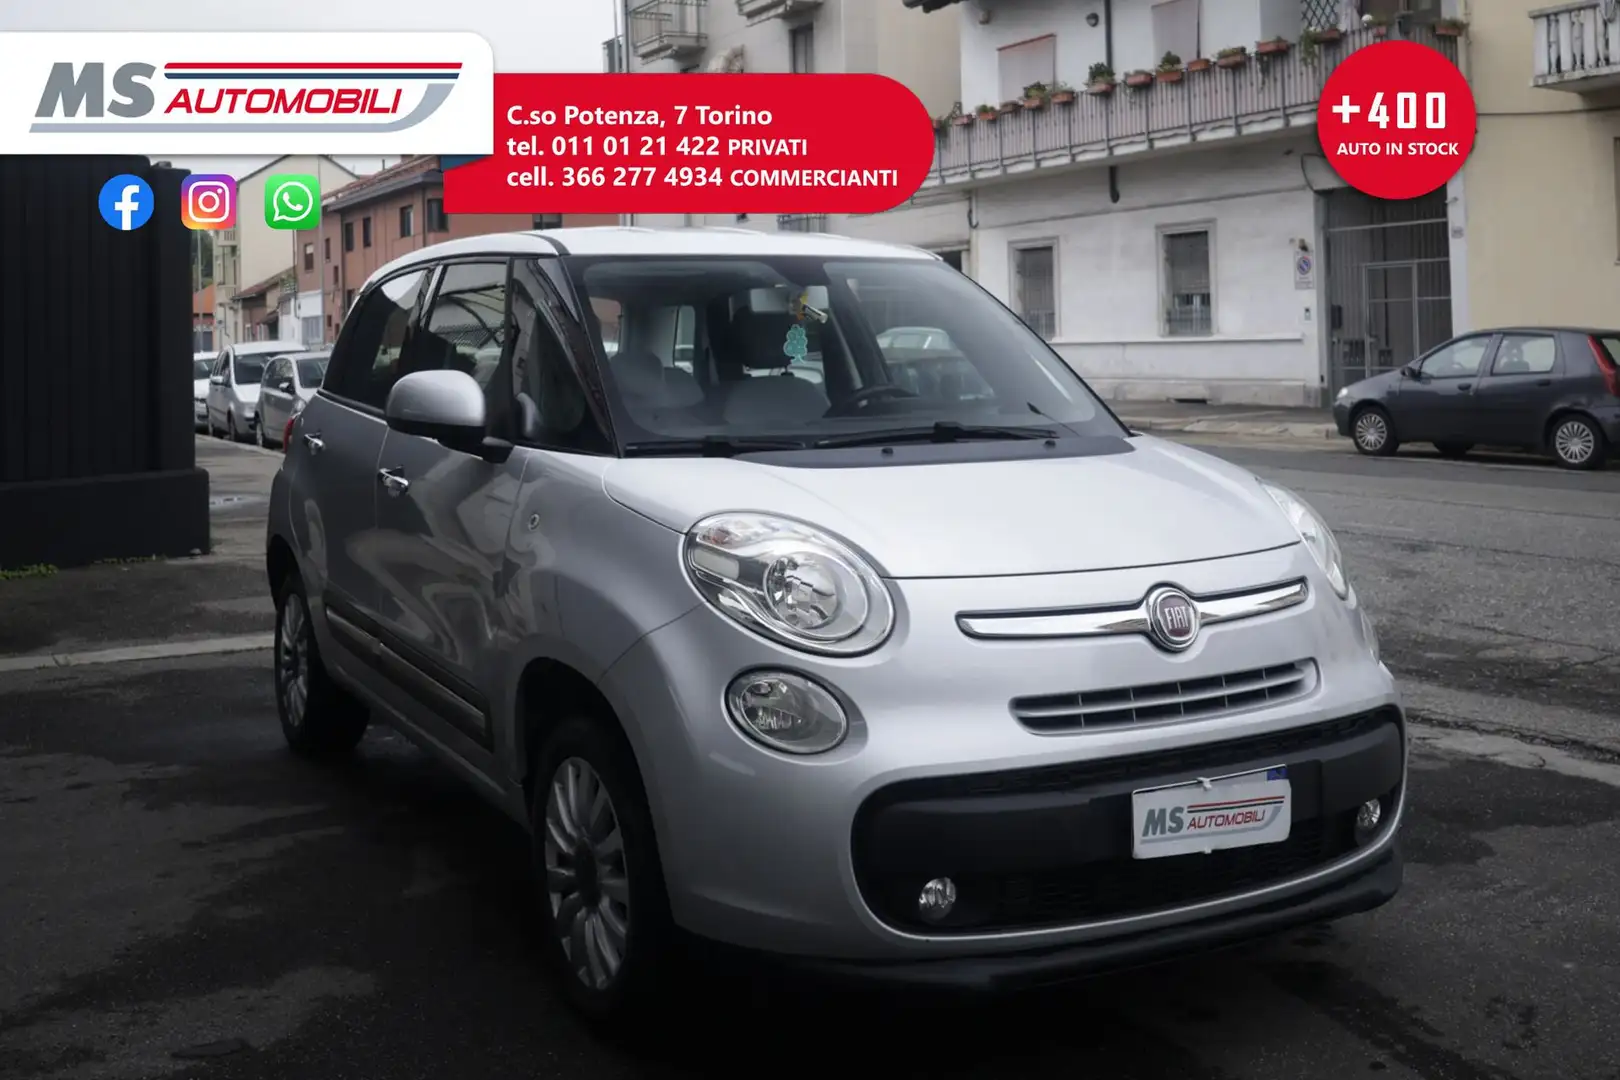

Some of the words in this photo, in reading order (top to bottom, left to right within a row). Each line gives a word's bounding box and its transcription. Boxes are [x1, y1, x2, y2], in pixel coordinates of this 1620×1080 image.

[1163, 606, 1189, 630] FIAT
[1141, 806, 1185, 838] MS
[1186, 810, 1266, 831] AUTOMOBILI
